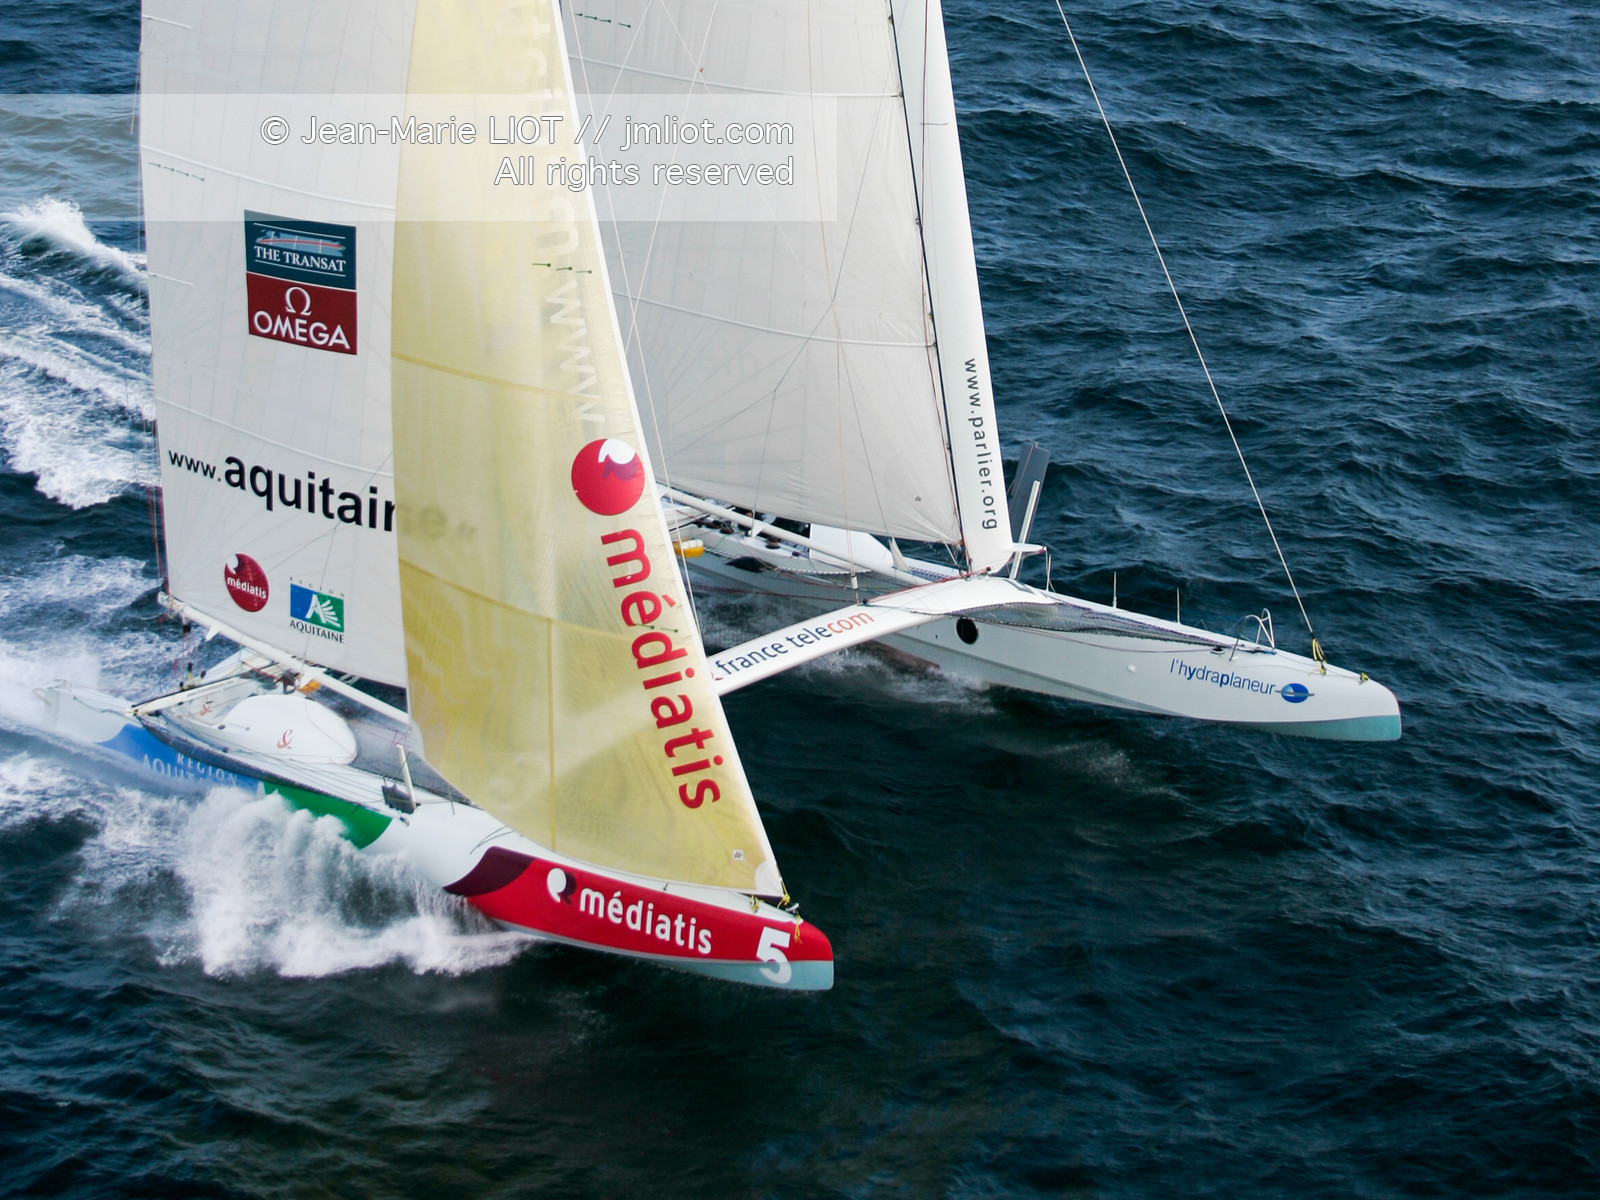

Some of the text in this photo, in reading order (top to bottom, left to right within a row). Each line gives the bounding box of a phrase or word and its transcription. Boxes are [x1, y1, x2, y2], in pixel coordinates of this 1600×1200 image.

[254, 246, 346, 272] THE TRANSAT
[254, 310, 350, 349] OMEGA
[964, 358, 998, 530] www.parlier.org
[227, 576, 267, 599] médiatis
[289, 619, 345, 644] AQUITAINE
[715, 612, 875, 675] france telecom
[601, 528, 725, 809] médiatis
[1170, 658, 1276, 695] l'hydraplaneur
[579, 886, 713, 955] médiatis
[756, 926, 792, 984] 5
